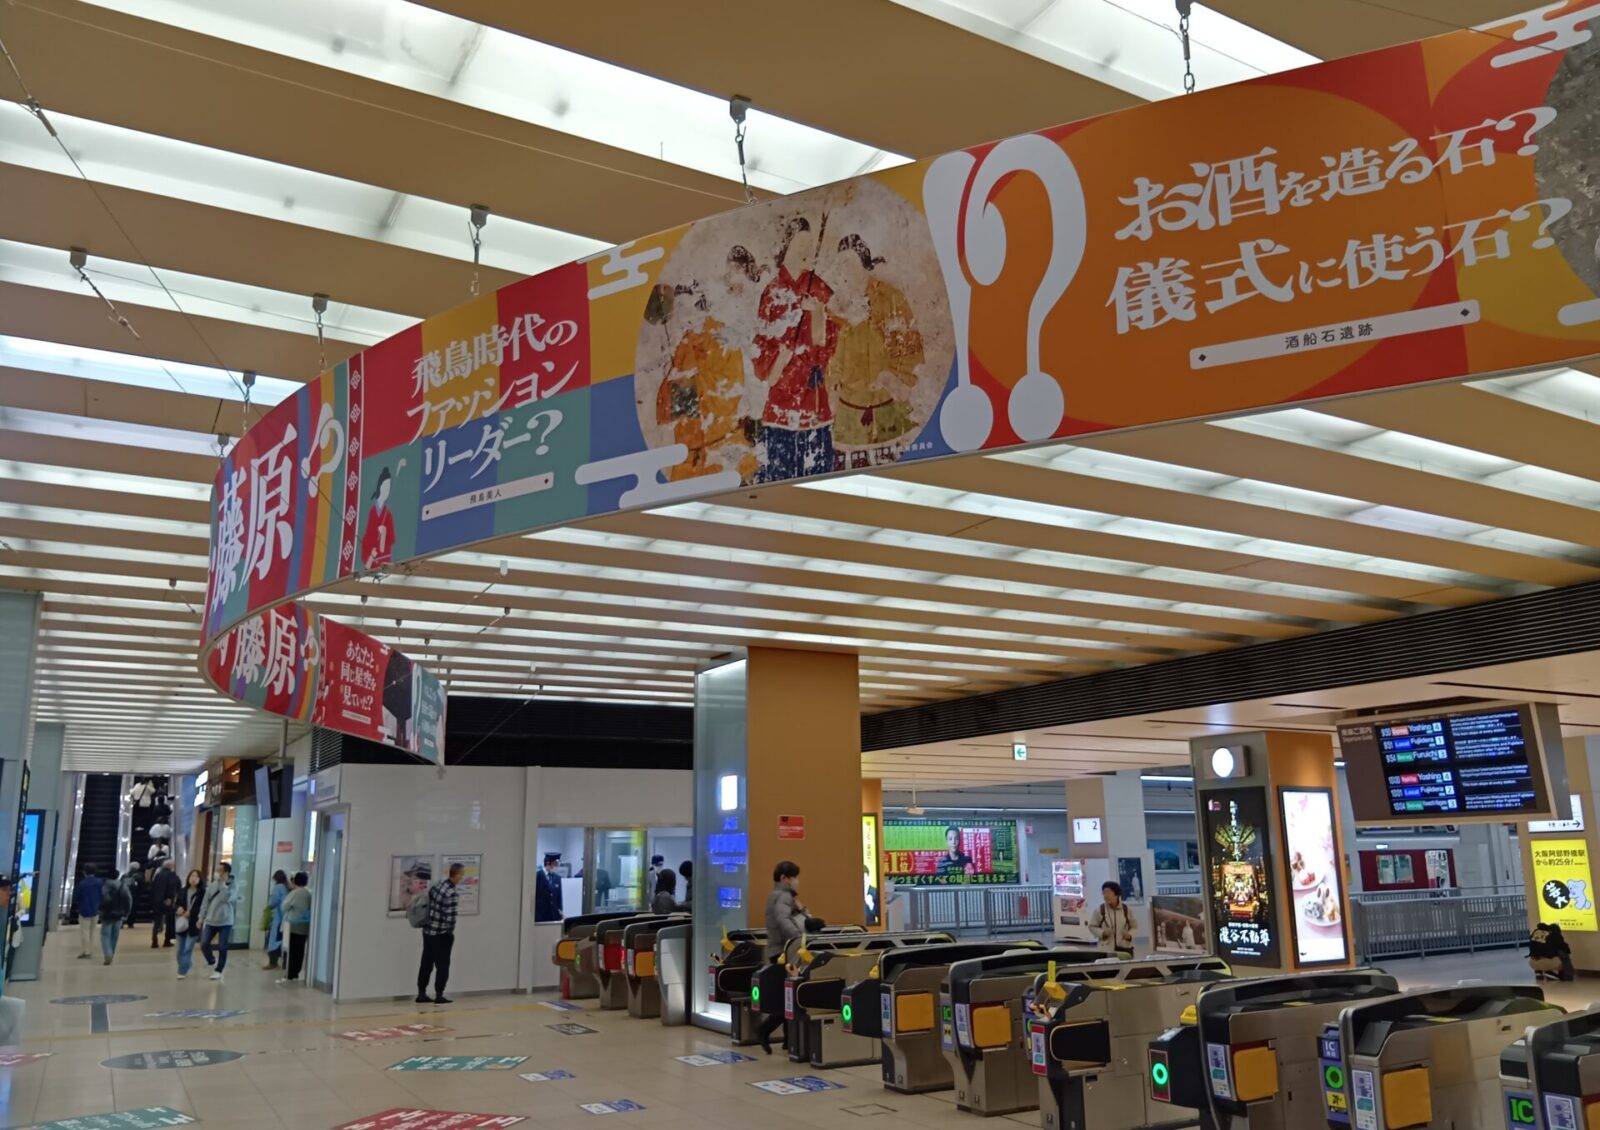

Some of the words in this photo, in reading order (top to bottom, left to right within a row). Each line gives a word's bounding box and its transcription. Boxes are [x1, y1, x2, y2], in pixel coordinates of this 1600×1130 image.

[1114, 106, 1557, 241] お酒を造る石?
[1106, 198, 1573, 334] 儀式に使う石?
[411, 313, 578, 399] 飛鳥時代の
[1285, 323, 1373, 349] 酒船石遺跡
[407, 360, 579, 446] ファッション
[424, 409, 563, 494] リーダー?
[1076, 822, 1081, 830] 1
[1093, 821, 1098, 830] 2
[1325, 1041, 1336, 1052] IC
[1511, 1098, 1534, 1123] IC
